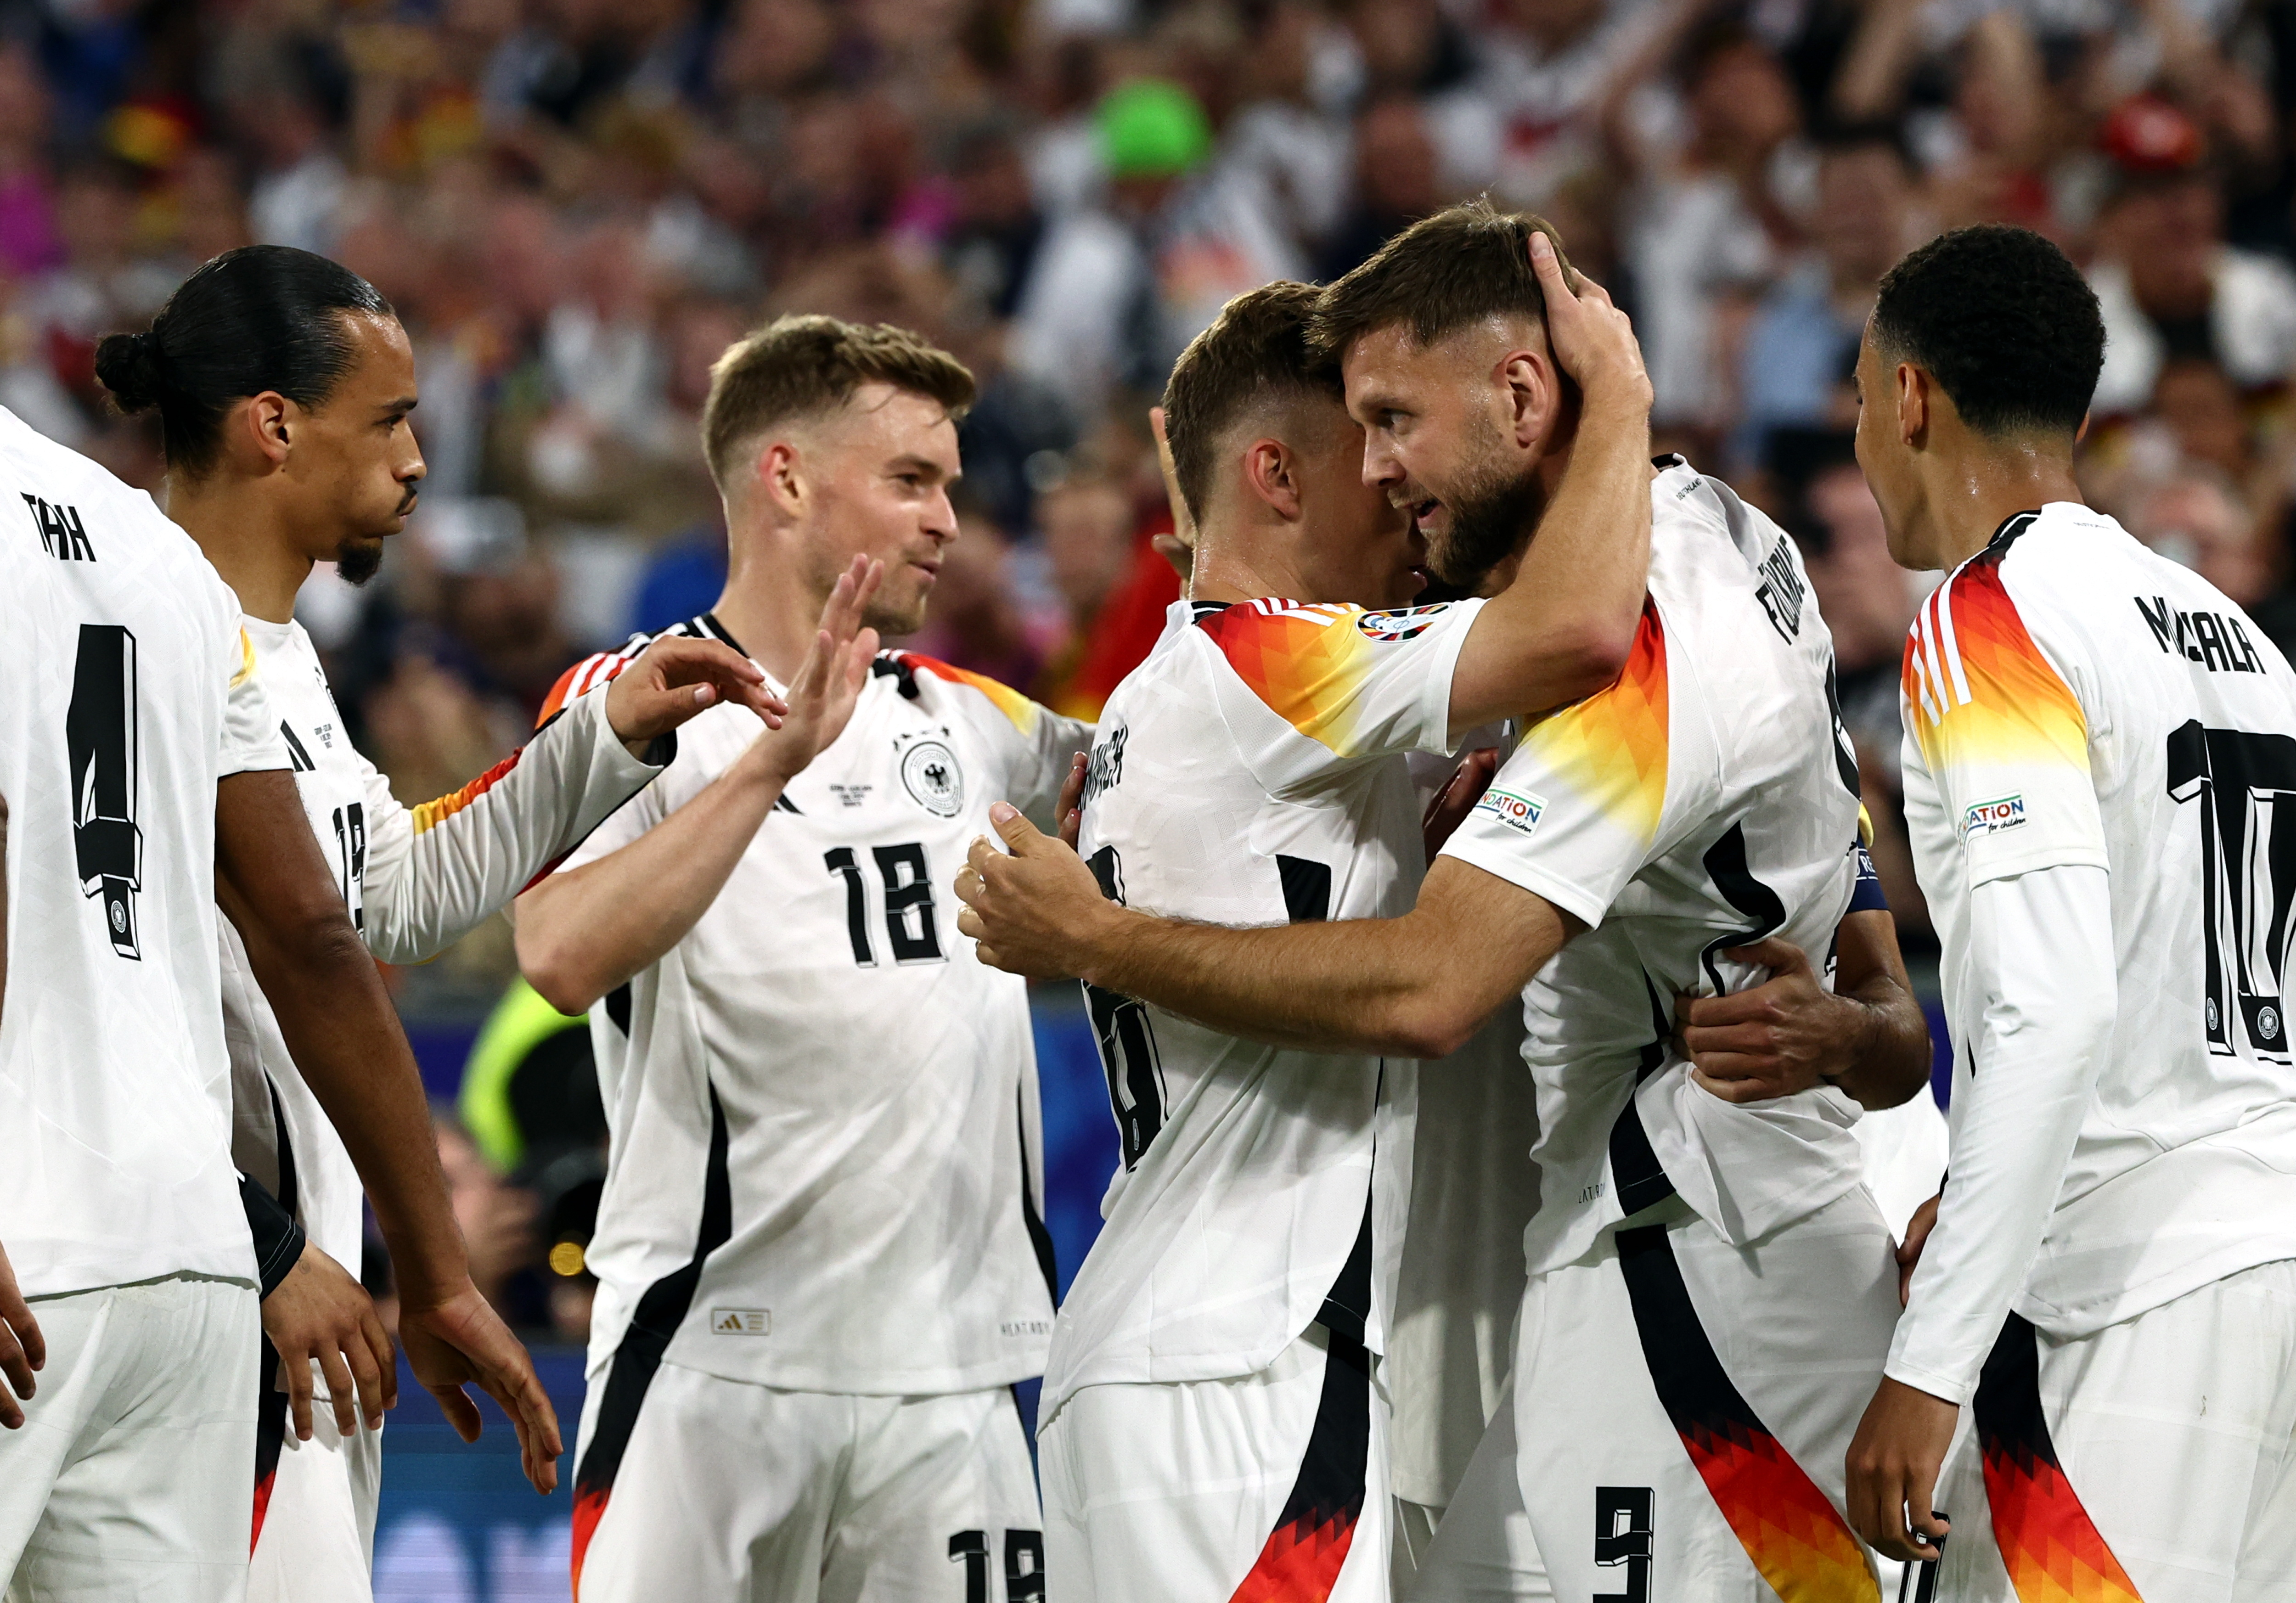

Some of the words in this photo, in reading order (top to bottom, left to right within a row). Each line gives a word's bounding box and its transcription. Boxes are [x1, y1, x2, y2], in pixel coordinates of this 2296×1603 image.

[20, 491, 96, 562] TAH
[66, 624, 143, 961] 4
[1496, 812, 1506, 821] for
[1507, 818, 1532, 833] children
[1988, 823, 1998, 834] for
[2000, 817, 2026, 829] children
[823, 841, 950, 968] 18
[1593, 1486, 1655, 1603] 9
